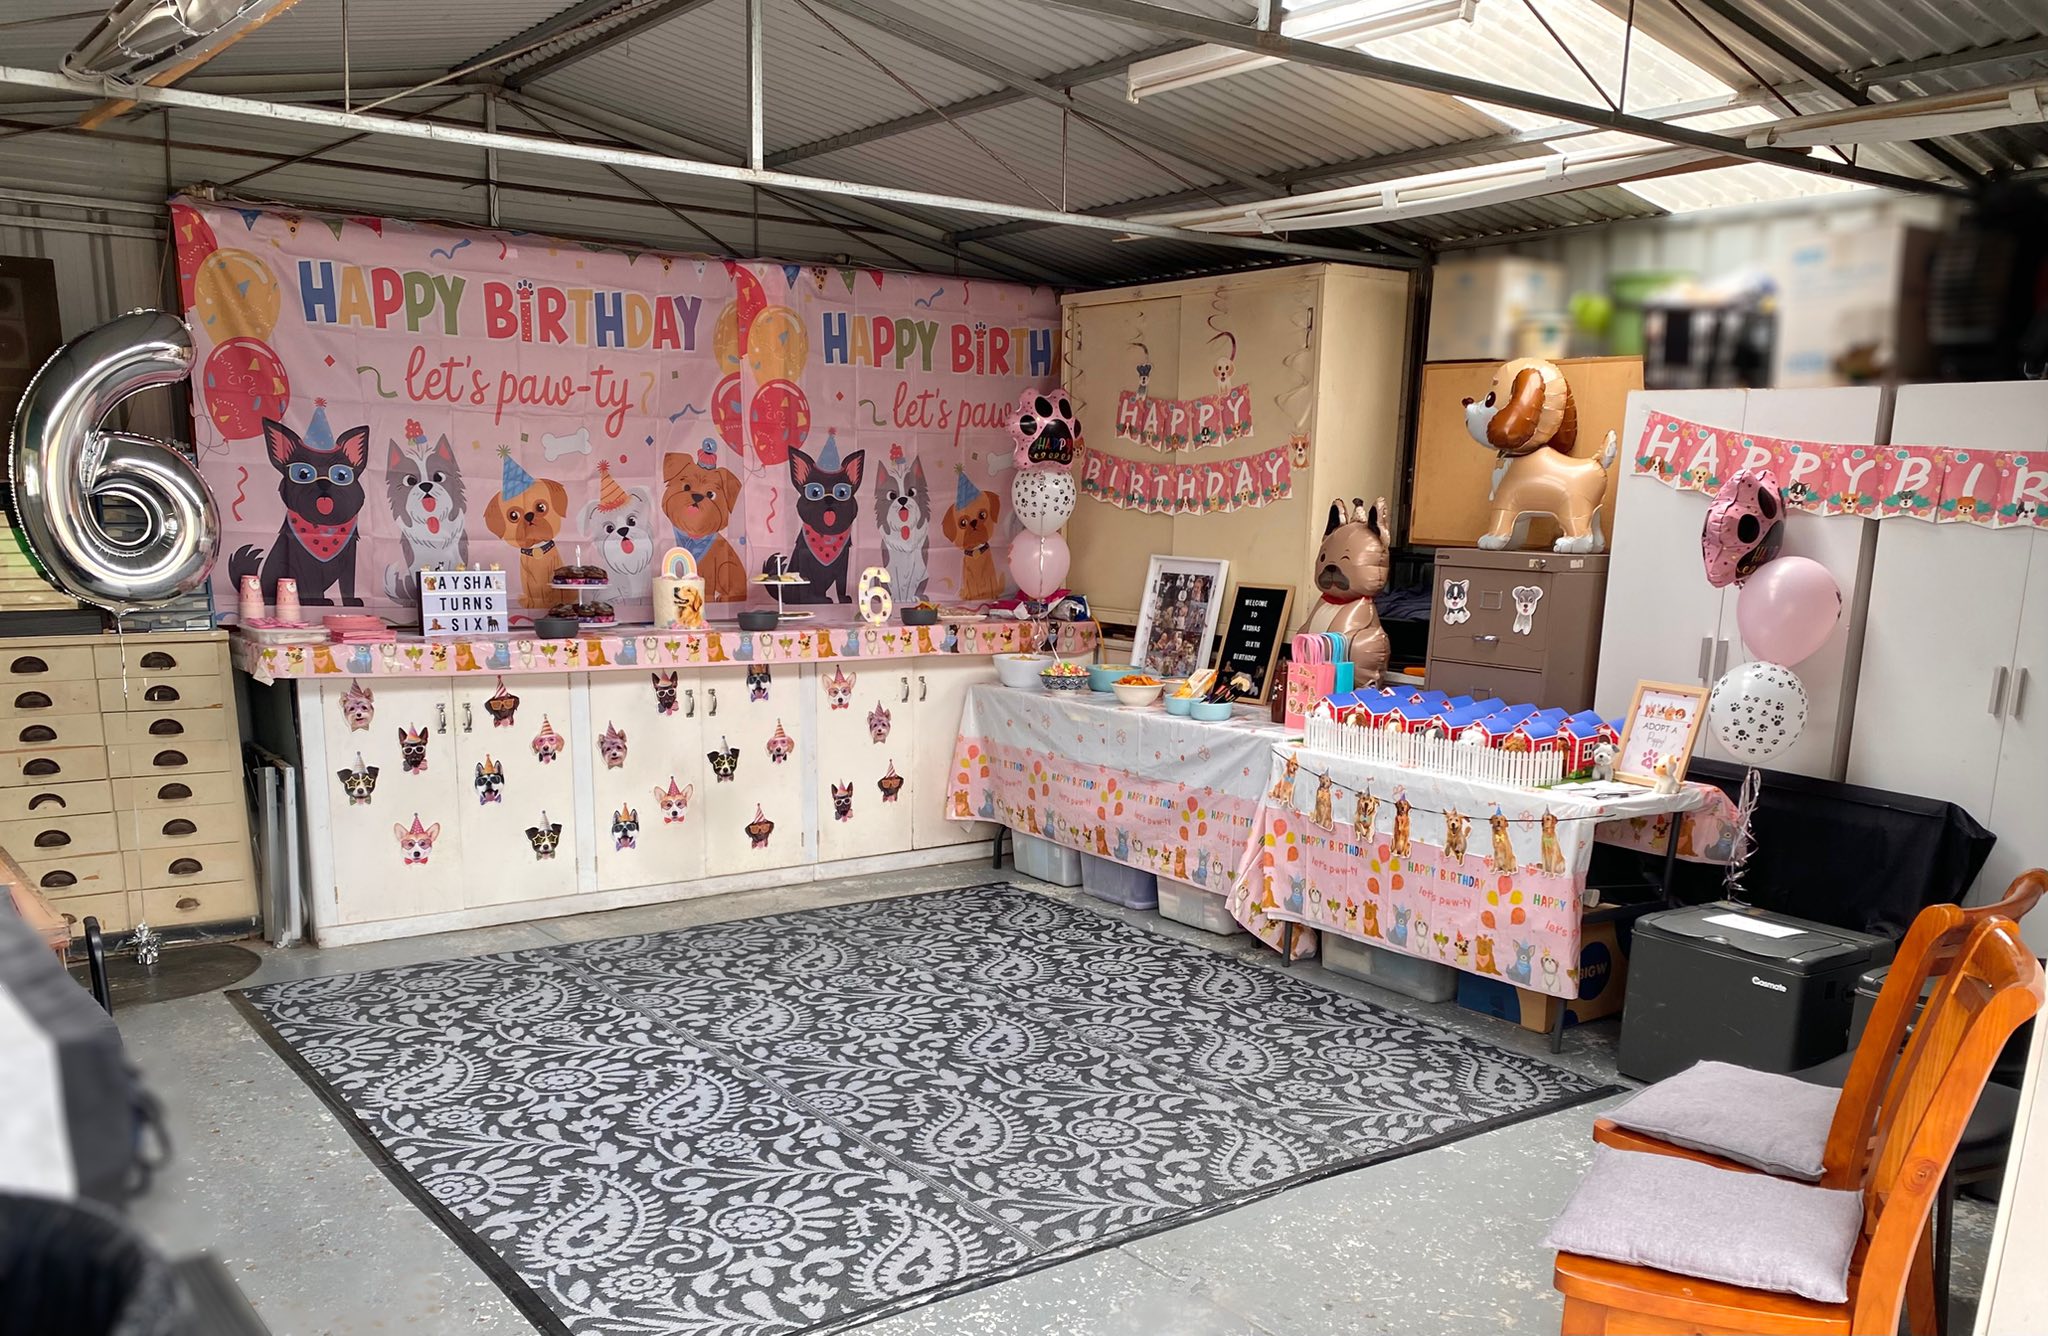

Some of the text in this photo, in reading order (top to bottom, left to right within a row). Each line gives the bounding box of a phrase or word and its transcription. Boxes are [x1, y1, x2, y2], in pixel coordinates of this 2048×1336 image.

[297, 260, 467, 336] HAPPY
[822, 312, 940, 372] HAPPY
[405, 345, 634, 439] let's paw-ty
[892, 380, 953, 430] let's
[1119, 395, 1245, 436] HAPPY
[1086, 456, 1284, 500] BIRTHDAY
[438, 575, 493, 590] AYSHA
[858, 566, 893, 625] 6
[439, 596, 493, 611] TURNS
[1245, 598, 1268, 608] WELCOME
[451, 617, 482, 632] SIX
[1642, 722, 1670, 732] ADOPT
[1301, 833, 1369, 859] HAPPY BIRTHDAY
[1408, 861, 1486, 891] HAPPY BIRTHDAY
[1533, 893, 1567, 912] HAPPY
[1545, 919, 1568, 937] let's
